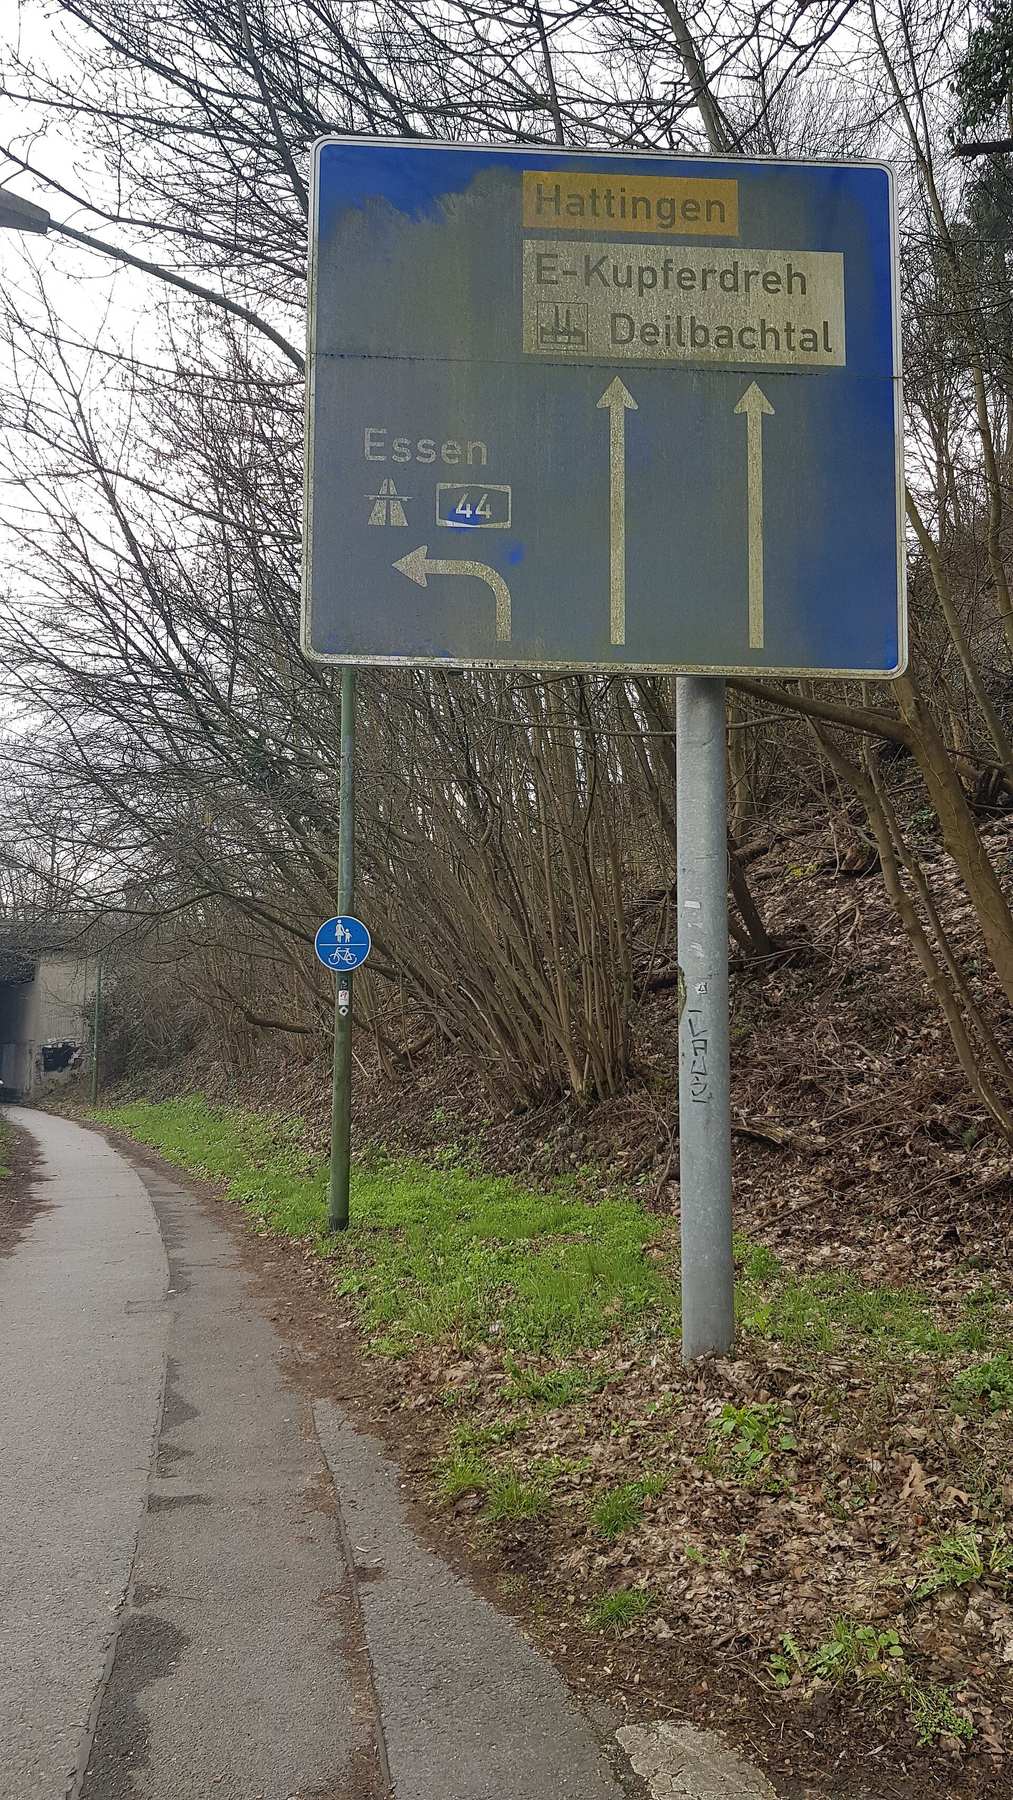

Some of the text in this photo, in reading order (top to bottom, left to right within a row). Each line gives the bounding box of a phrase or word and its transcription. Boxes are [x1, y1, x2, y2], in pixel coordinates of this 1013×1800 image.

[535, 183, 726, 229] Hattingen
[535, 252, 807, 297] E-Kupferdreh
[610, 312, 833, 353] Deilbachtal
[364, 427, 488, 465] Essen
[455, 492, 493, 519] 44
